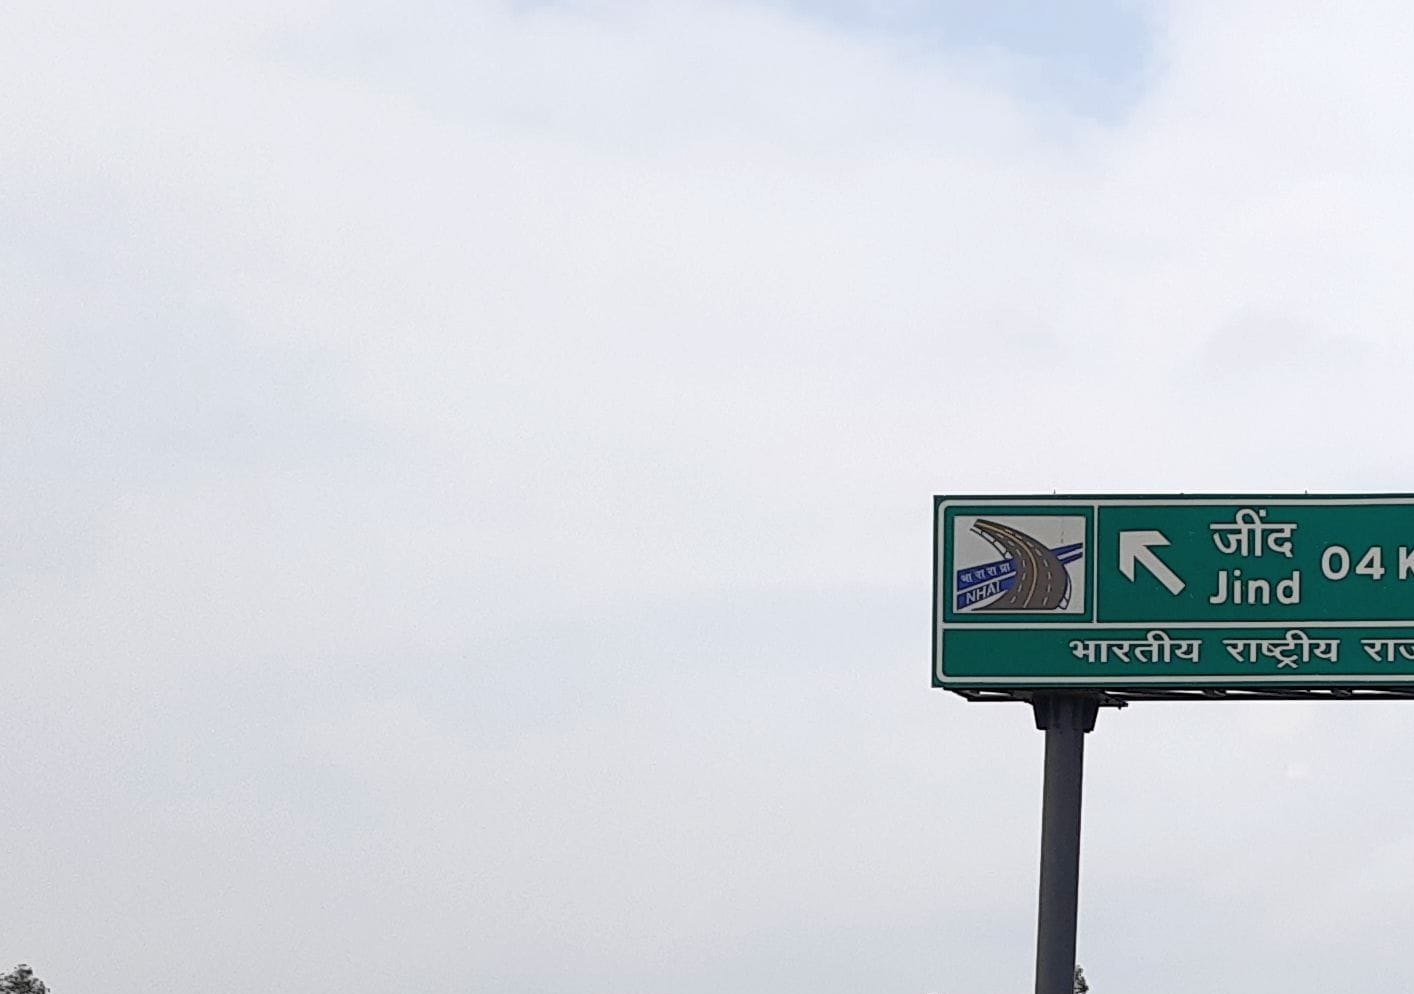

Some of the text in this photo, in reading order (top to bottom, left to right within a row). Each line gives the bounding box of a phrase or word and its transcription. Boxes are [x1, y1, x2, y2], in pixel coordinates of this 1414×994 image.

[1211, 509, 1298, 558] जींद
[1323, 547, 1386, 581] 04
[965, 580, 1000, 604] NHAI
[1211, 570, 1301, 605] Jind
[1070, 631, 1203, 663] भारतीय
[1225, 630, 1340, 669] राष्ट्रीय
